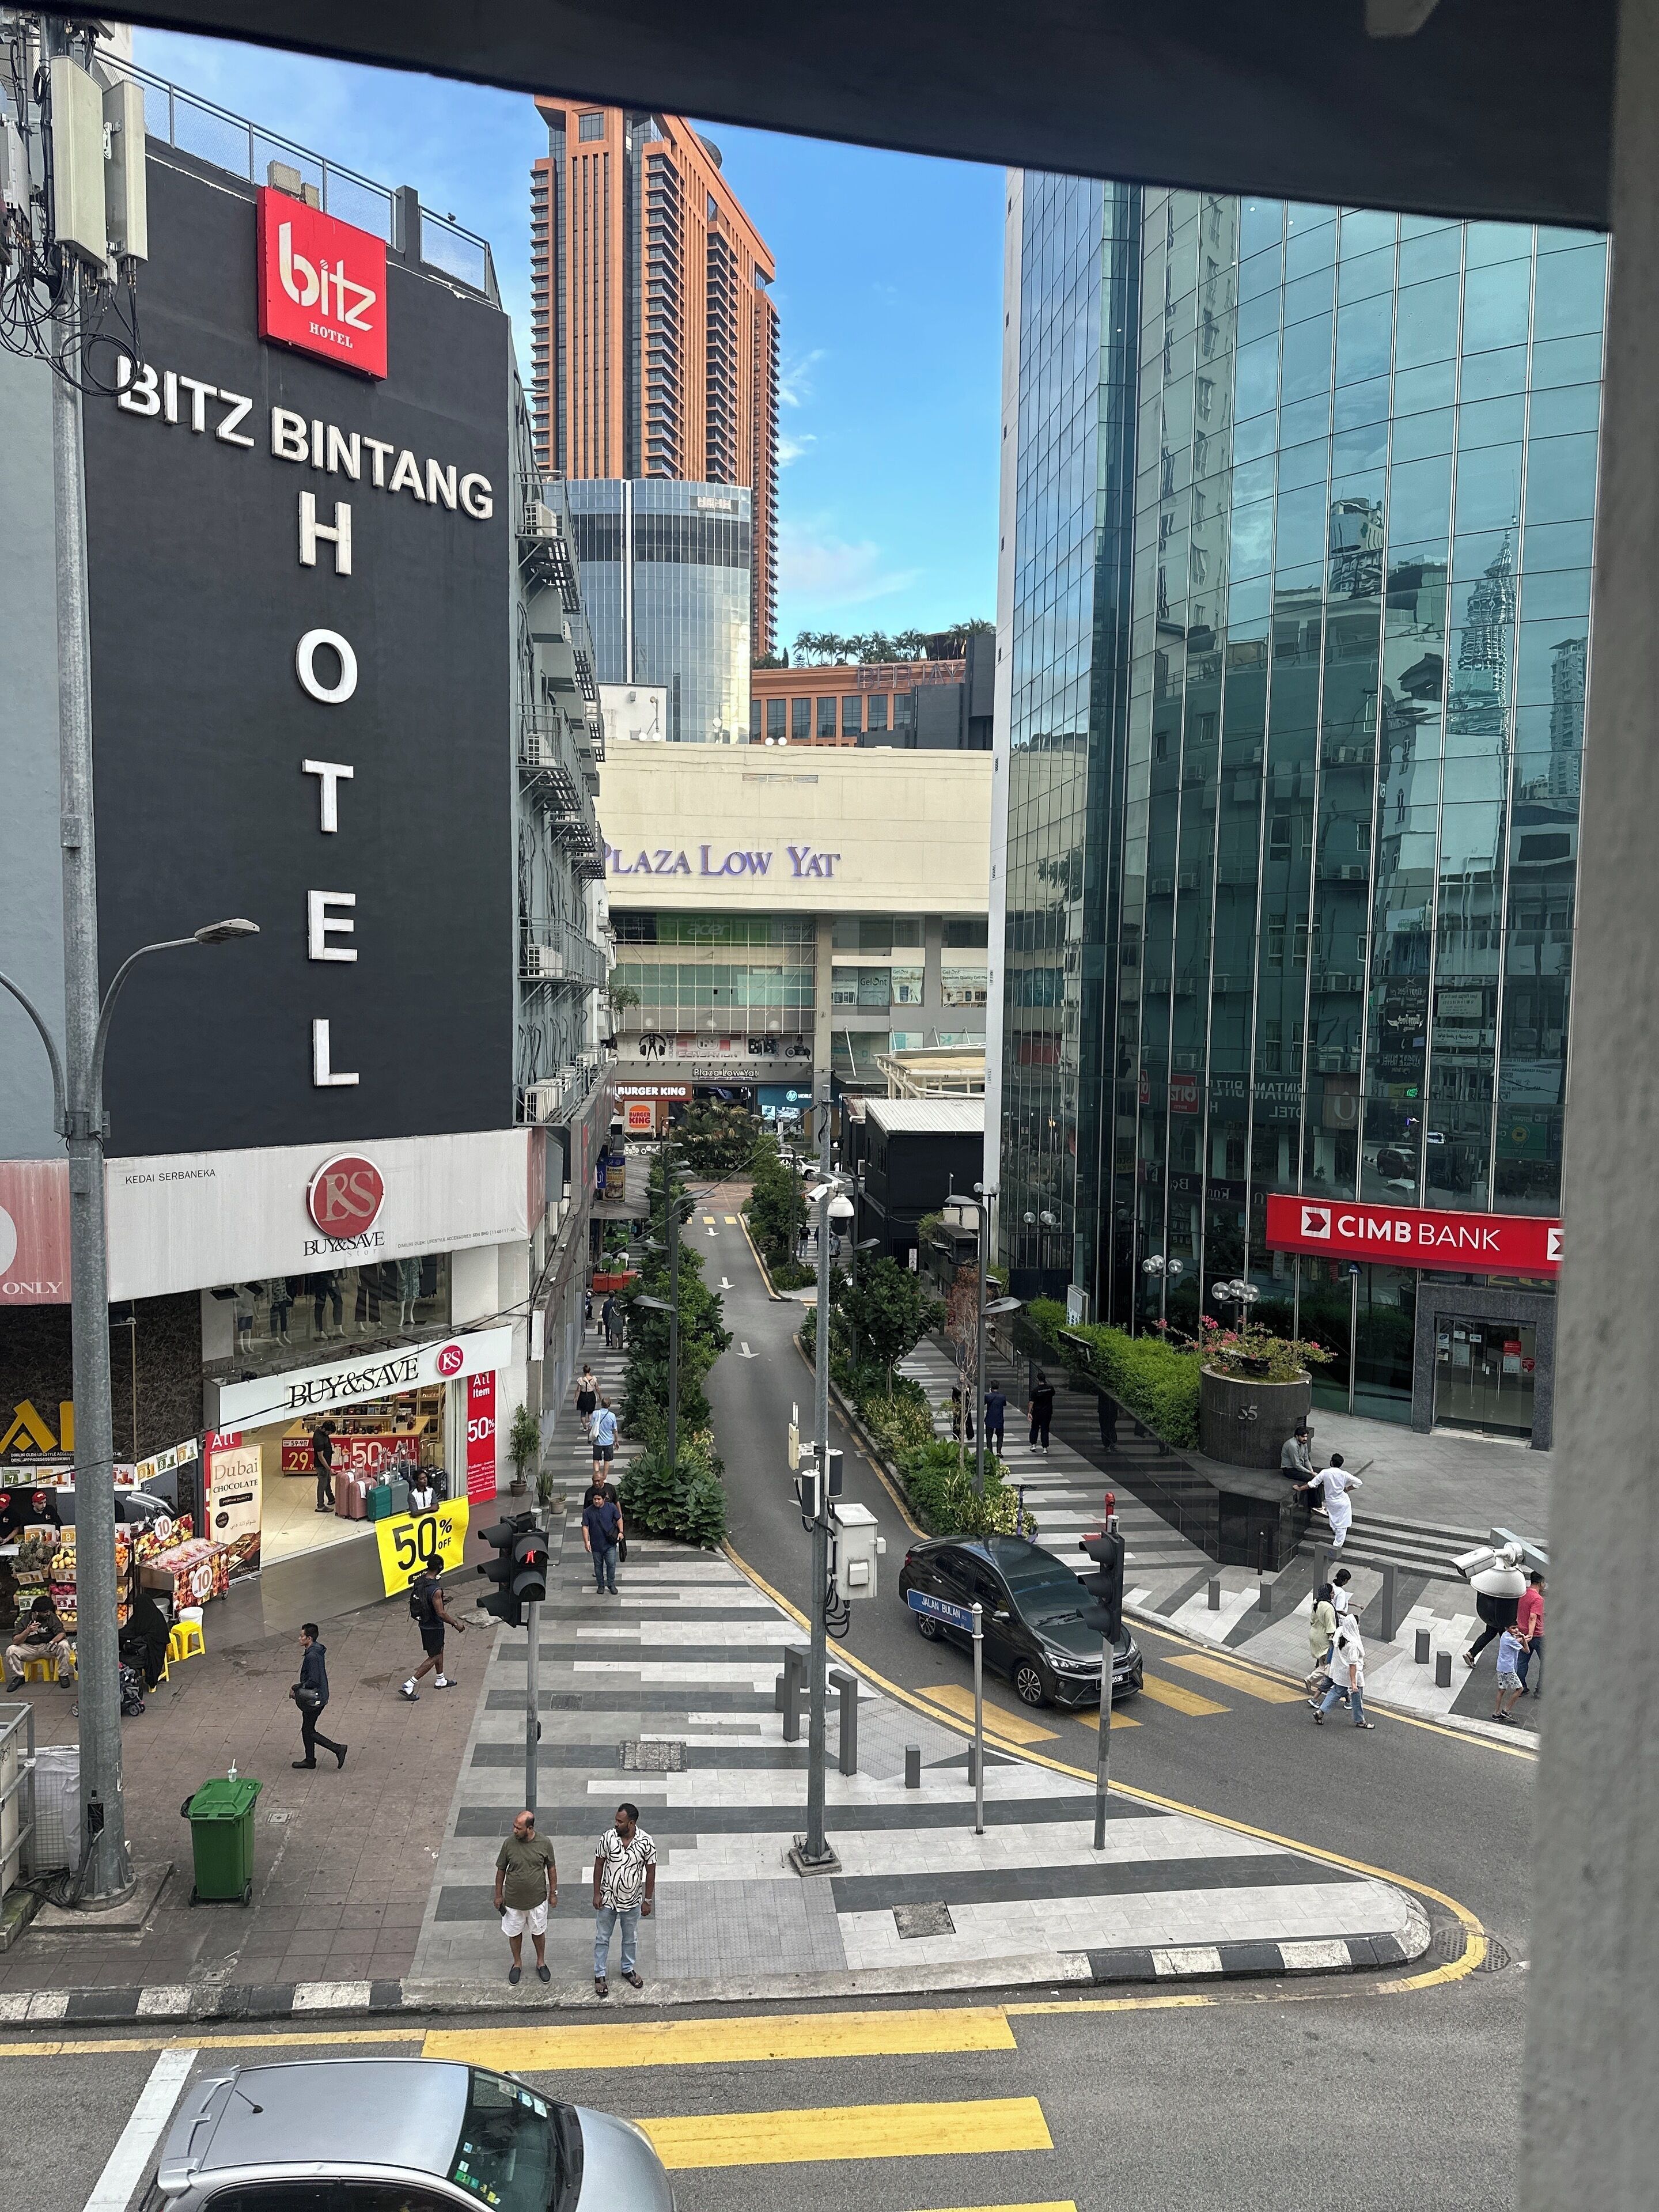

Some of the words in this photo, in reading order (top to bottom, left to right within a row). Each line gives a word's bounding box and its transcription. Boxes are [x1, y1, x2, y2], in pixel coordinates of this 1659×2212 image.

[278, 222, 376, 331] bitz
[309, 321, 353, 348] HOTEL
[117, 355, 254, 448] BITZ
[271, 407, 493, 520] BINTANG
[296, 490, 359, 1086] HOTEL
[700, 845, 772, 876] LOW
[786, 846, 840, 876] YAT
[687, 923, 730, 935] acer
[618, 1087, 658, 1096] BURGER
[660, 1088, 685, 1096] KING
[125, 1174, 155, 1184] KEDAI
[158, 1168, 215, 1181] SERBANEKA
[304, 1231, 385, 1256] BUY&SAVE
[1338, 1215, 1411, 1243] CIMB
[1419, 1222, 1501, 1251] BANK
[2, 1282, 62, 1294] ONLY
[287, 1358, 419, 1408] BUY&SAVE
[473, 1387, 490, 1398] Item
[468, 1416, 495, 1442] 50%
[9, 1475, 14, 1483] 7
[214, 1458, 258, 1480] Dubai
[213, 1479, 258, 1494] CHOCOLATE
[66, 1533, 71, 1541] 8
[158, 1519, 169, 1537] 10
[392, 1517, 452, 1570] 50%
[438, 1537, 451, 1550] OFF
[198, 1570, 210, 1592] 10
[922, 1597, 939, 1611] JALAN
[942, 1604, 960, 1619] BULAN
